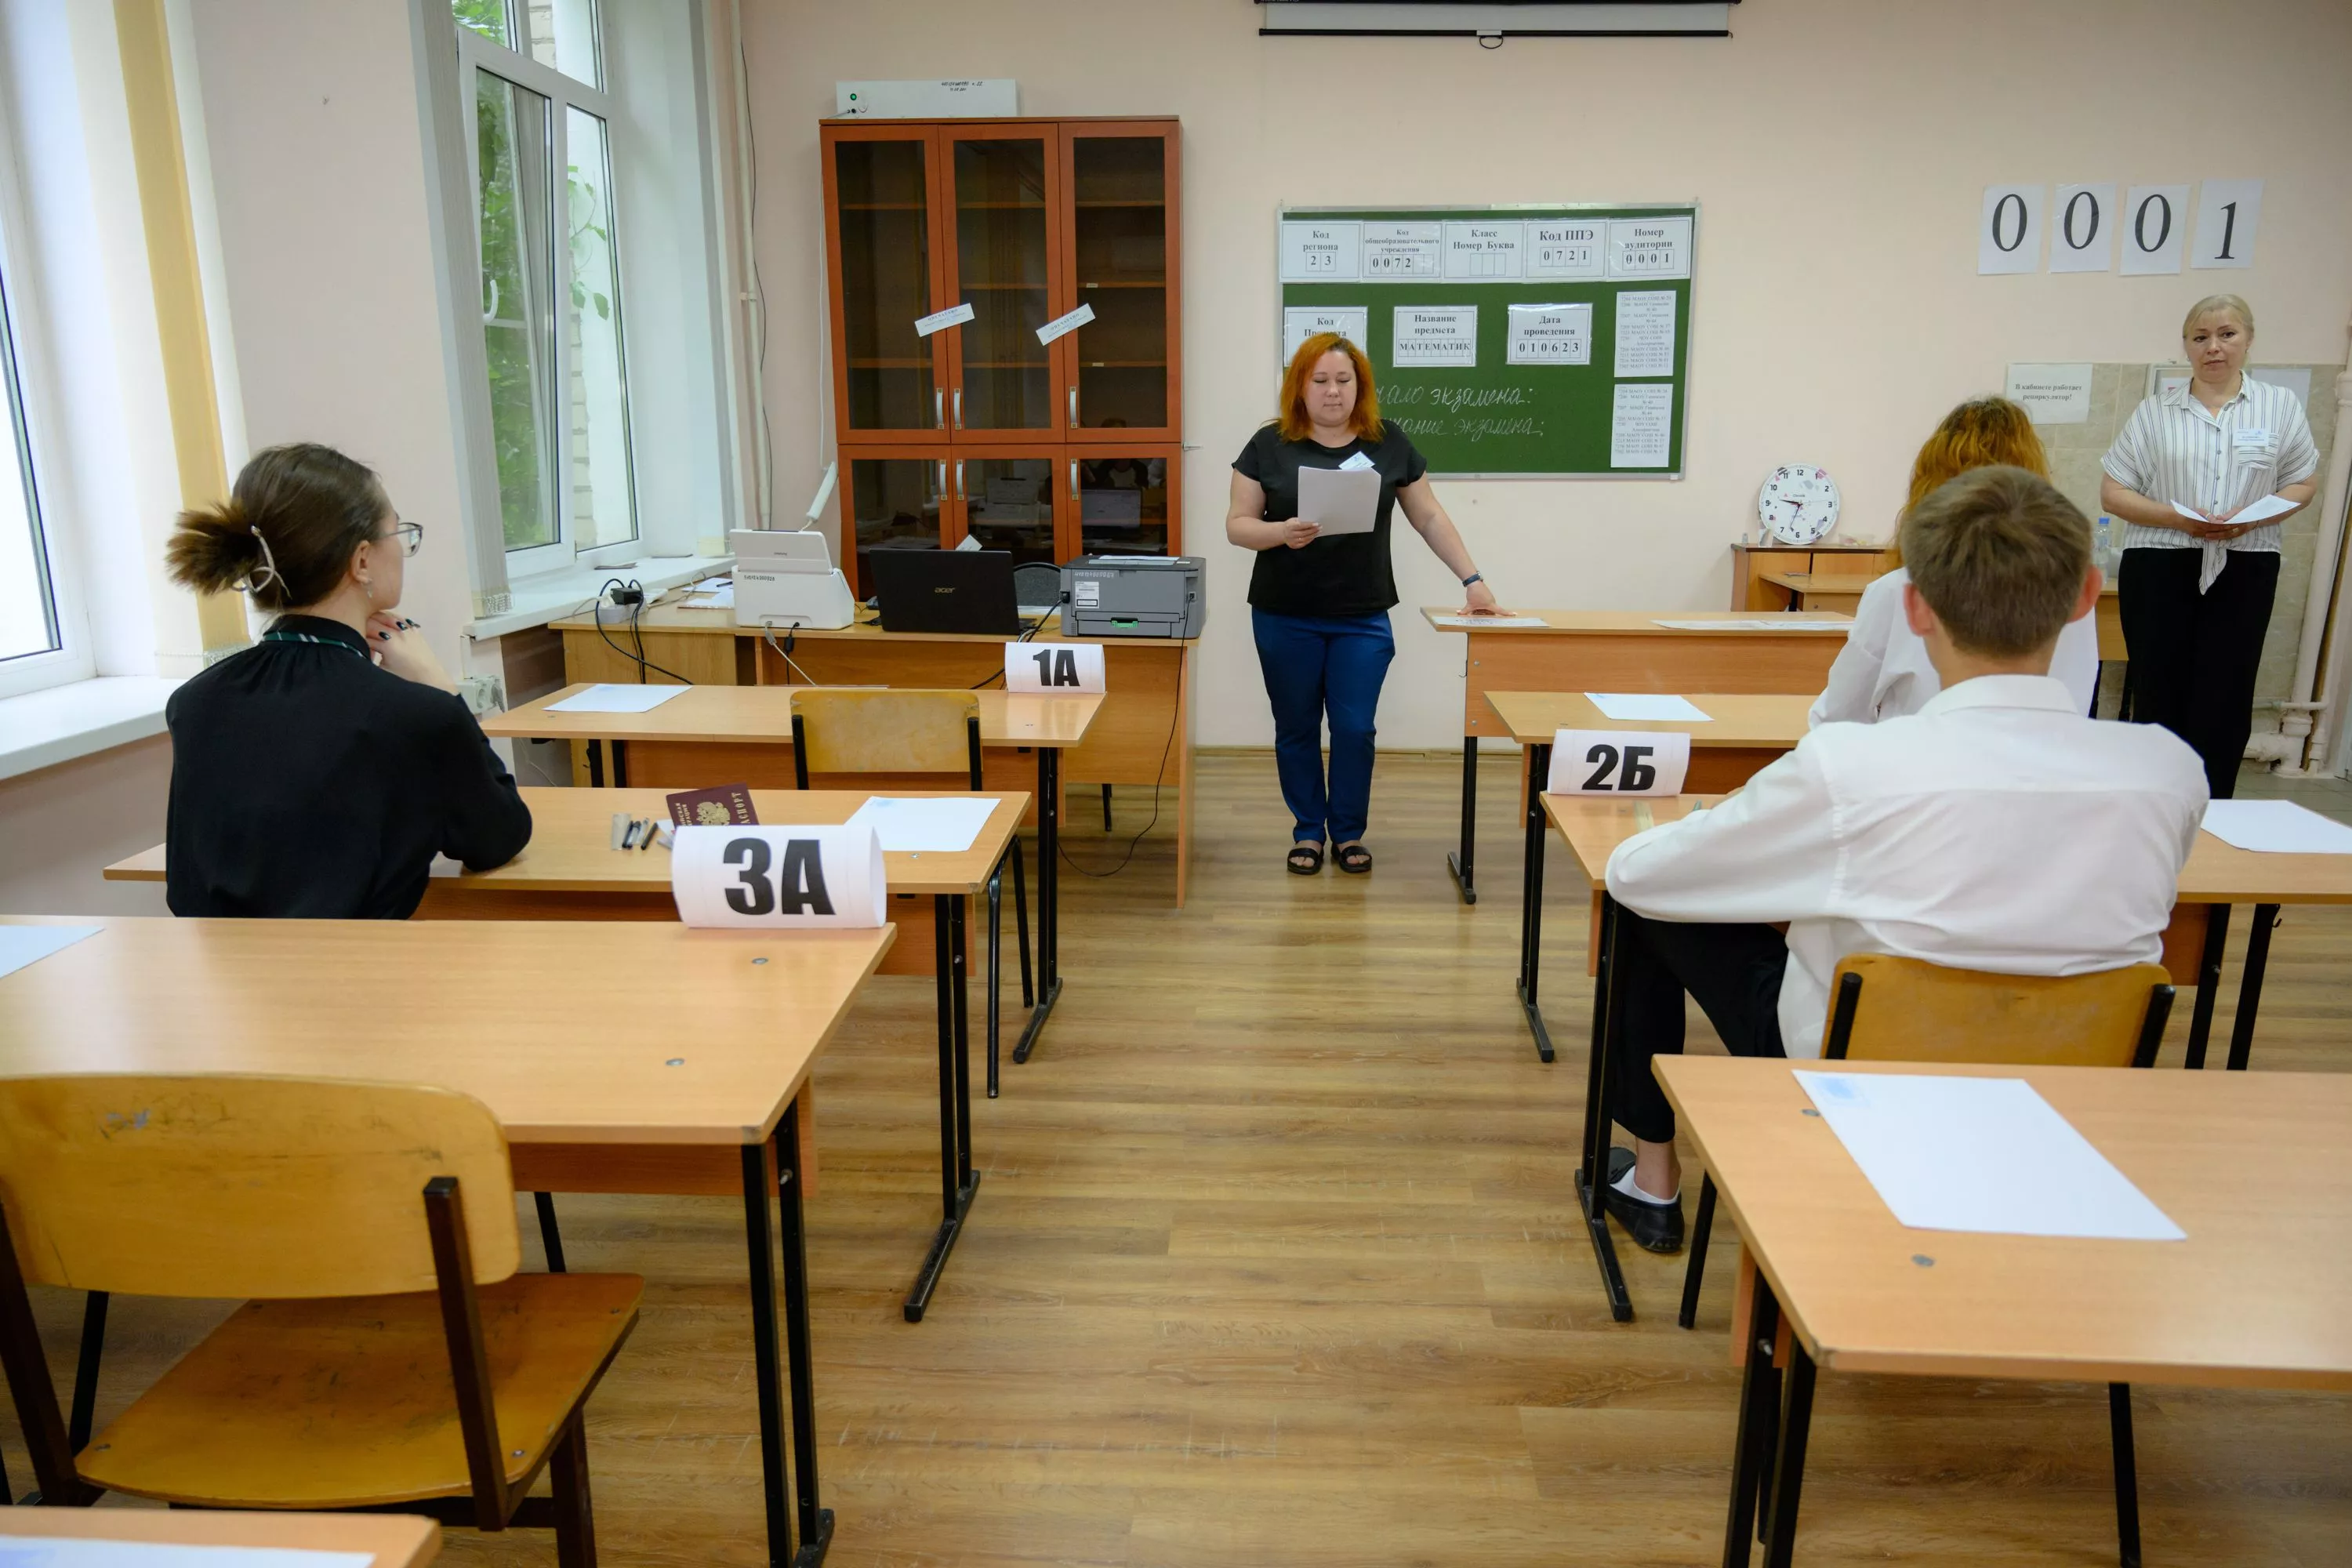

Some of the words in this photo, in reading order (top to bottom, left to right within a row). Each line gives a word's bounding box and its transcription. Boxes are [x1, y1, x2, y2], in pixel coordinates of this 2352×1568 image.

[1312, 230, 1330, 239] Код
[1472, 229, 1497, 238] Класс
[1539, 230, 1562, 241] Код
[1565, 230, 1594, 241] ППЭ
[1634, 228, 1664, 238] Номер
[1303, 243, 1338, 252] региона
[1453, 241, 1483, 250] Номер
[1487, 241, 1515, 251] Буква
[1624, 240, 1673, 249] аудитории
[1317, 317, 1334, 326] Код
[1414, 314, 1457, 323] Название
[1539, 315, 1561, 325] Дата
[1414, 325, 1456, 335] предмета
[1523, 327, 1575, 336] проведения
[1033, 648, 1080, 688] 1А
[1581, 744, 1656, 791] 2Б
[722, 837, 837, 915] 3А
